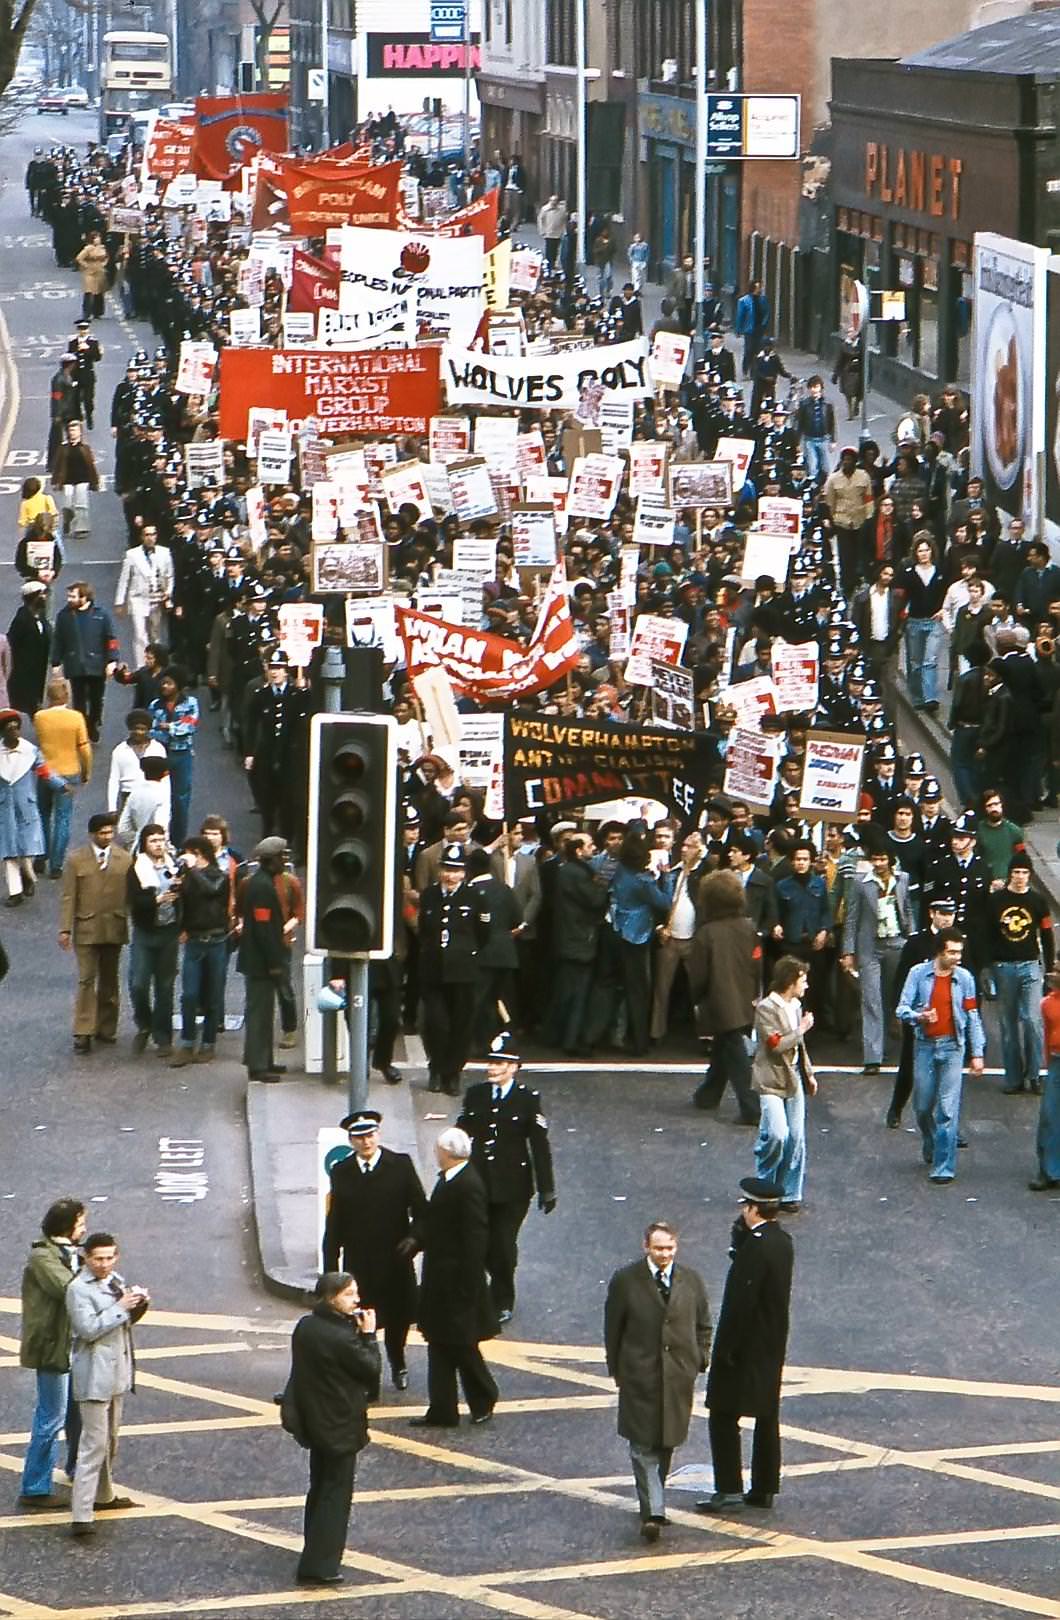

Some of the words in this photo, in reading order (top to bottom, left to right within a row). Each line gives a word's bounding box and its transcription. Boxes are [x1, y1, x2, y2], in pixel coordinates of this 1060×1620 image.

[865, 142, 963, 224] PLANET
[318, 192, 355, 206] POLY
[272, 354, 427, 374] INTERNATIONAL
[304, 376, 391, 395] MARXIST
[448, 358, 564, 402] WOLVES
[577, 355, 647, 401] POLY
[316, 397, 390, 416] GROUP
[288, 417, 427, 434] OVERHAMPTON
[510, 717, 696, 752] WOLVERHAMPTON
[523, 769, 696, 815] COMMITTEE
